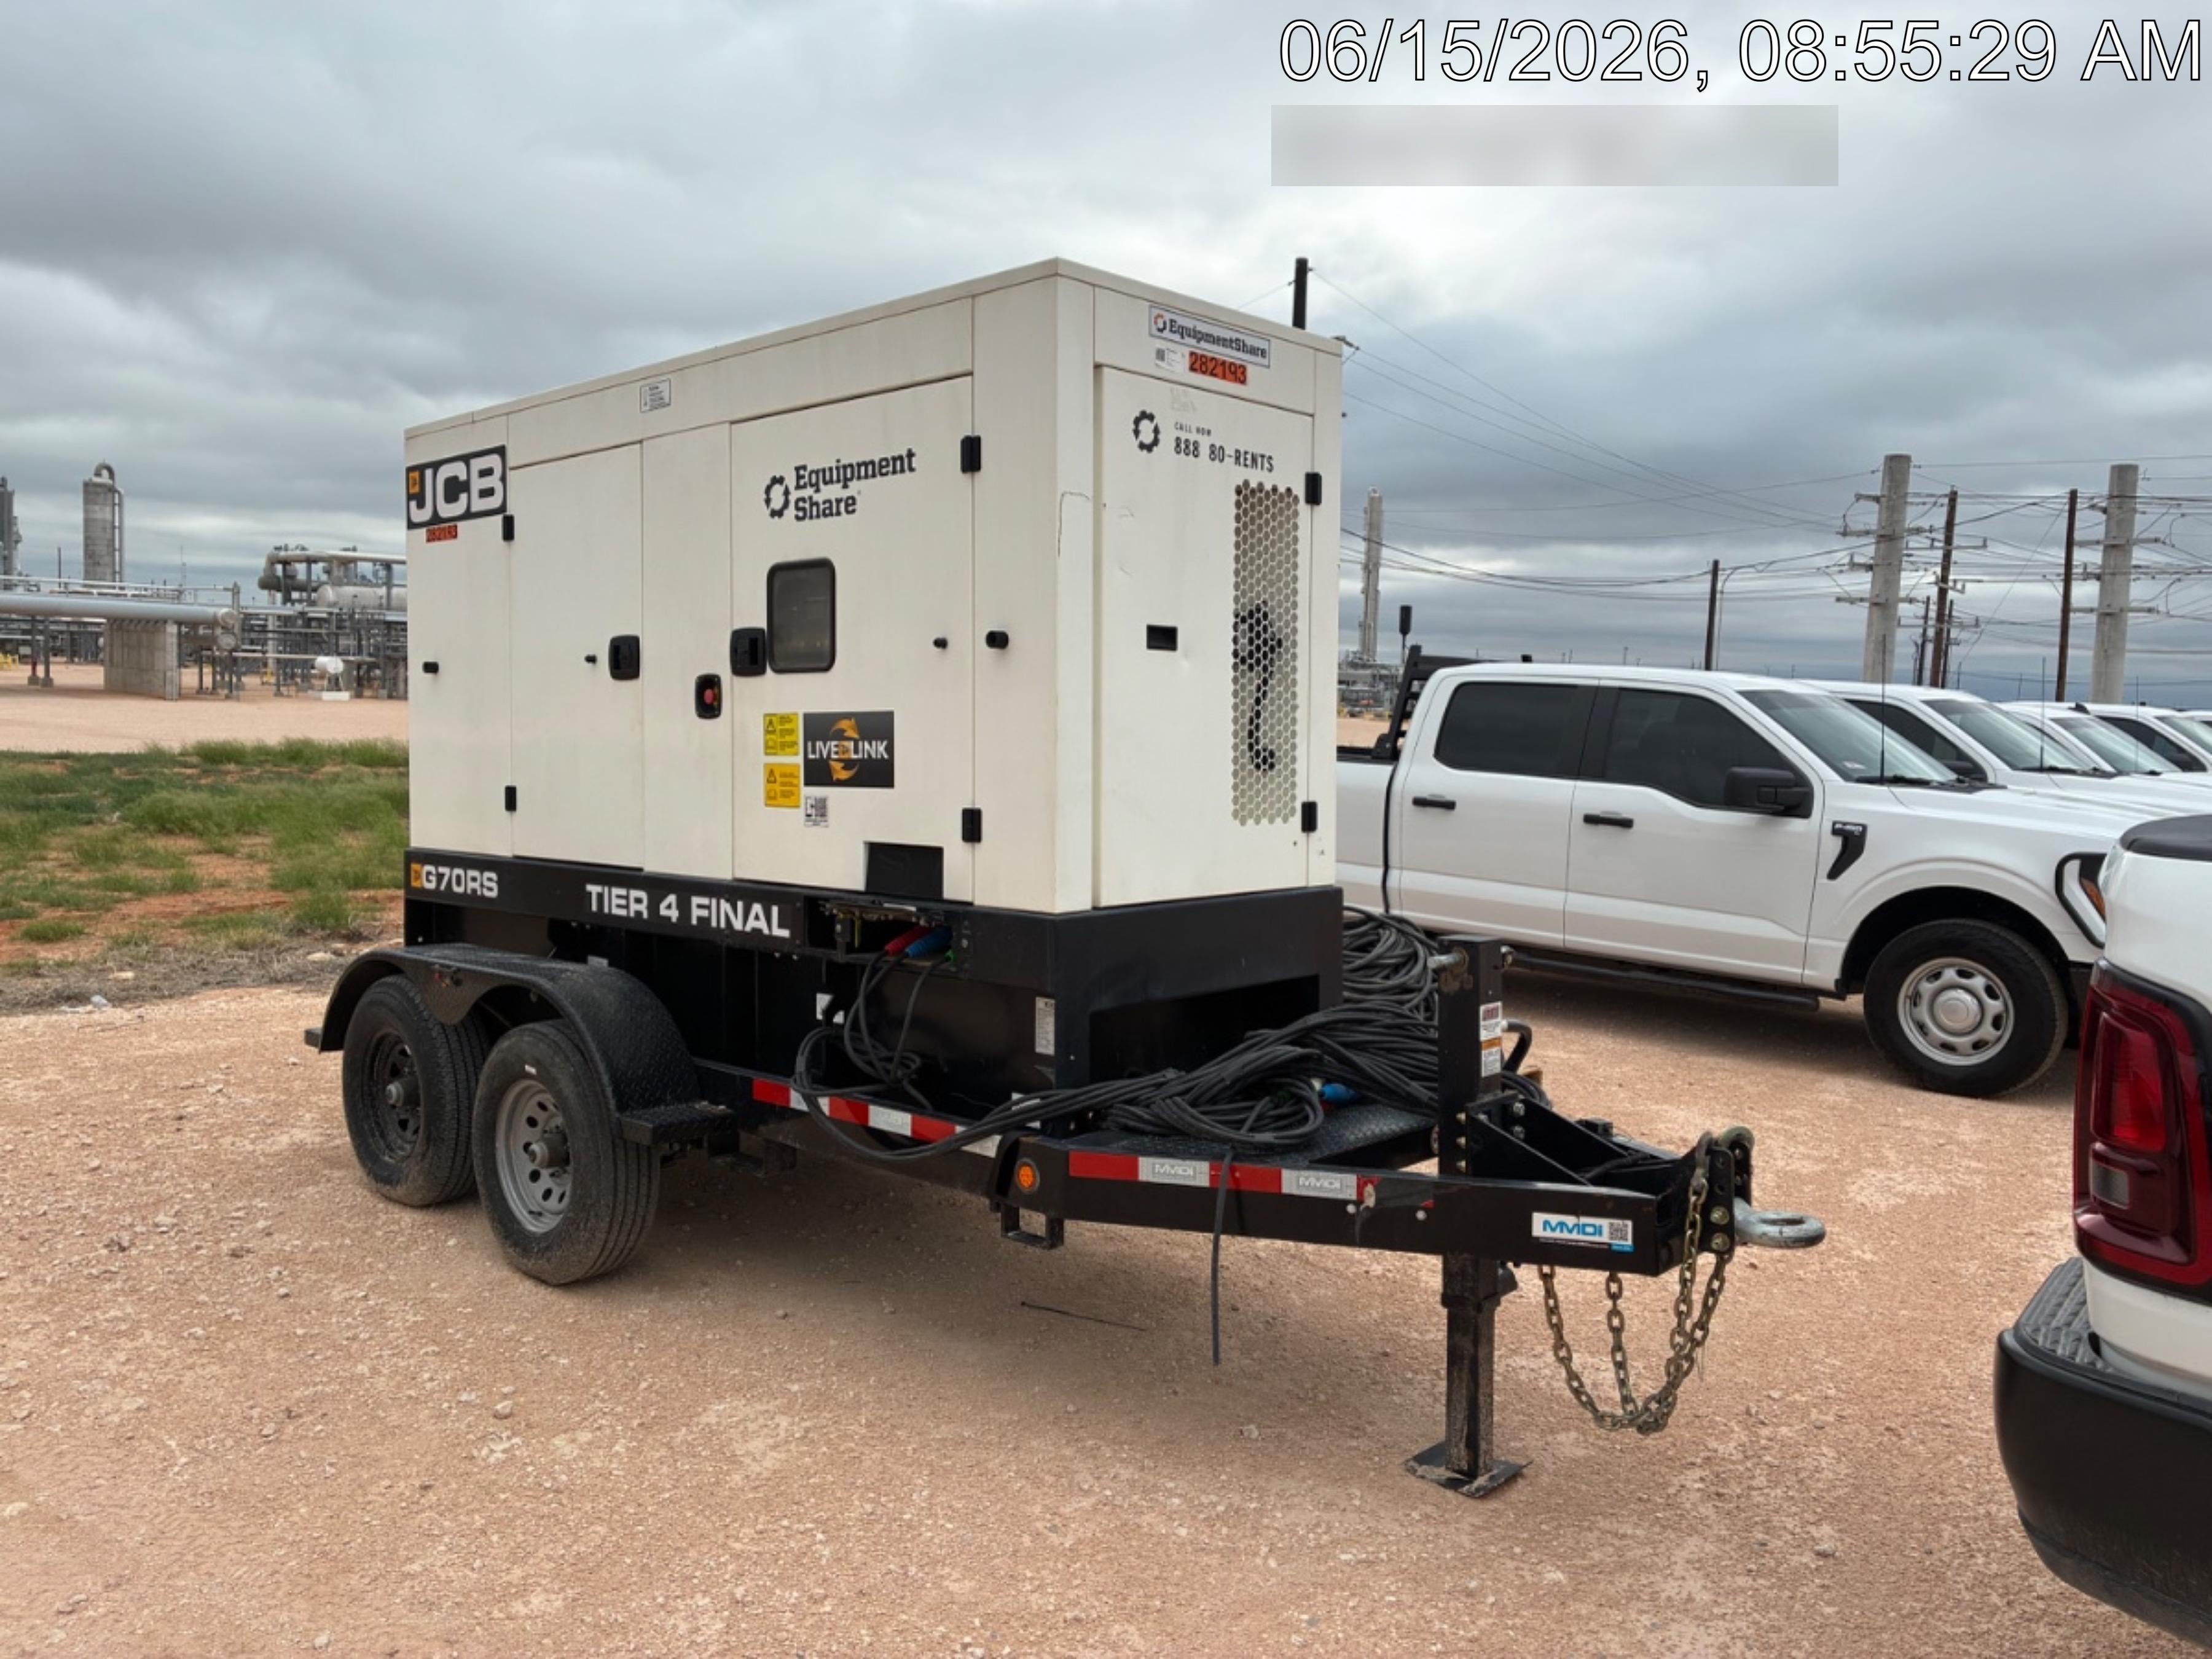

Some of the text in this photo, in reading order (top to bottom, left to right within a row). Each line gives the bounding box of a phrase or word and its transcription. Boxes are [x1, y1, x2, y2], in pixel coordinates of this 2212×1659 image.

[1168, 318, 1267, 359] EquipmentShare
[1190, 351, 1247, 385] 282193
[794, 448, 916, 493] Equipment
[1174, 436, 1274, 473] 888 80-RENTS
[409, 453, 504, 523] JCB
[794, 495, 857, 522] Share
[422, 864, 498, 898] G70RS
[586, 884, 790, 938] TIER 4 FINAL
